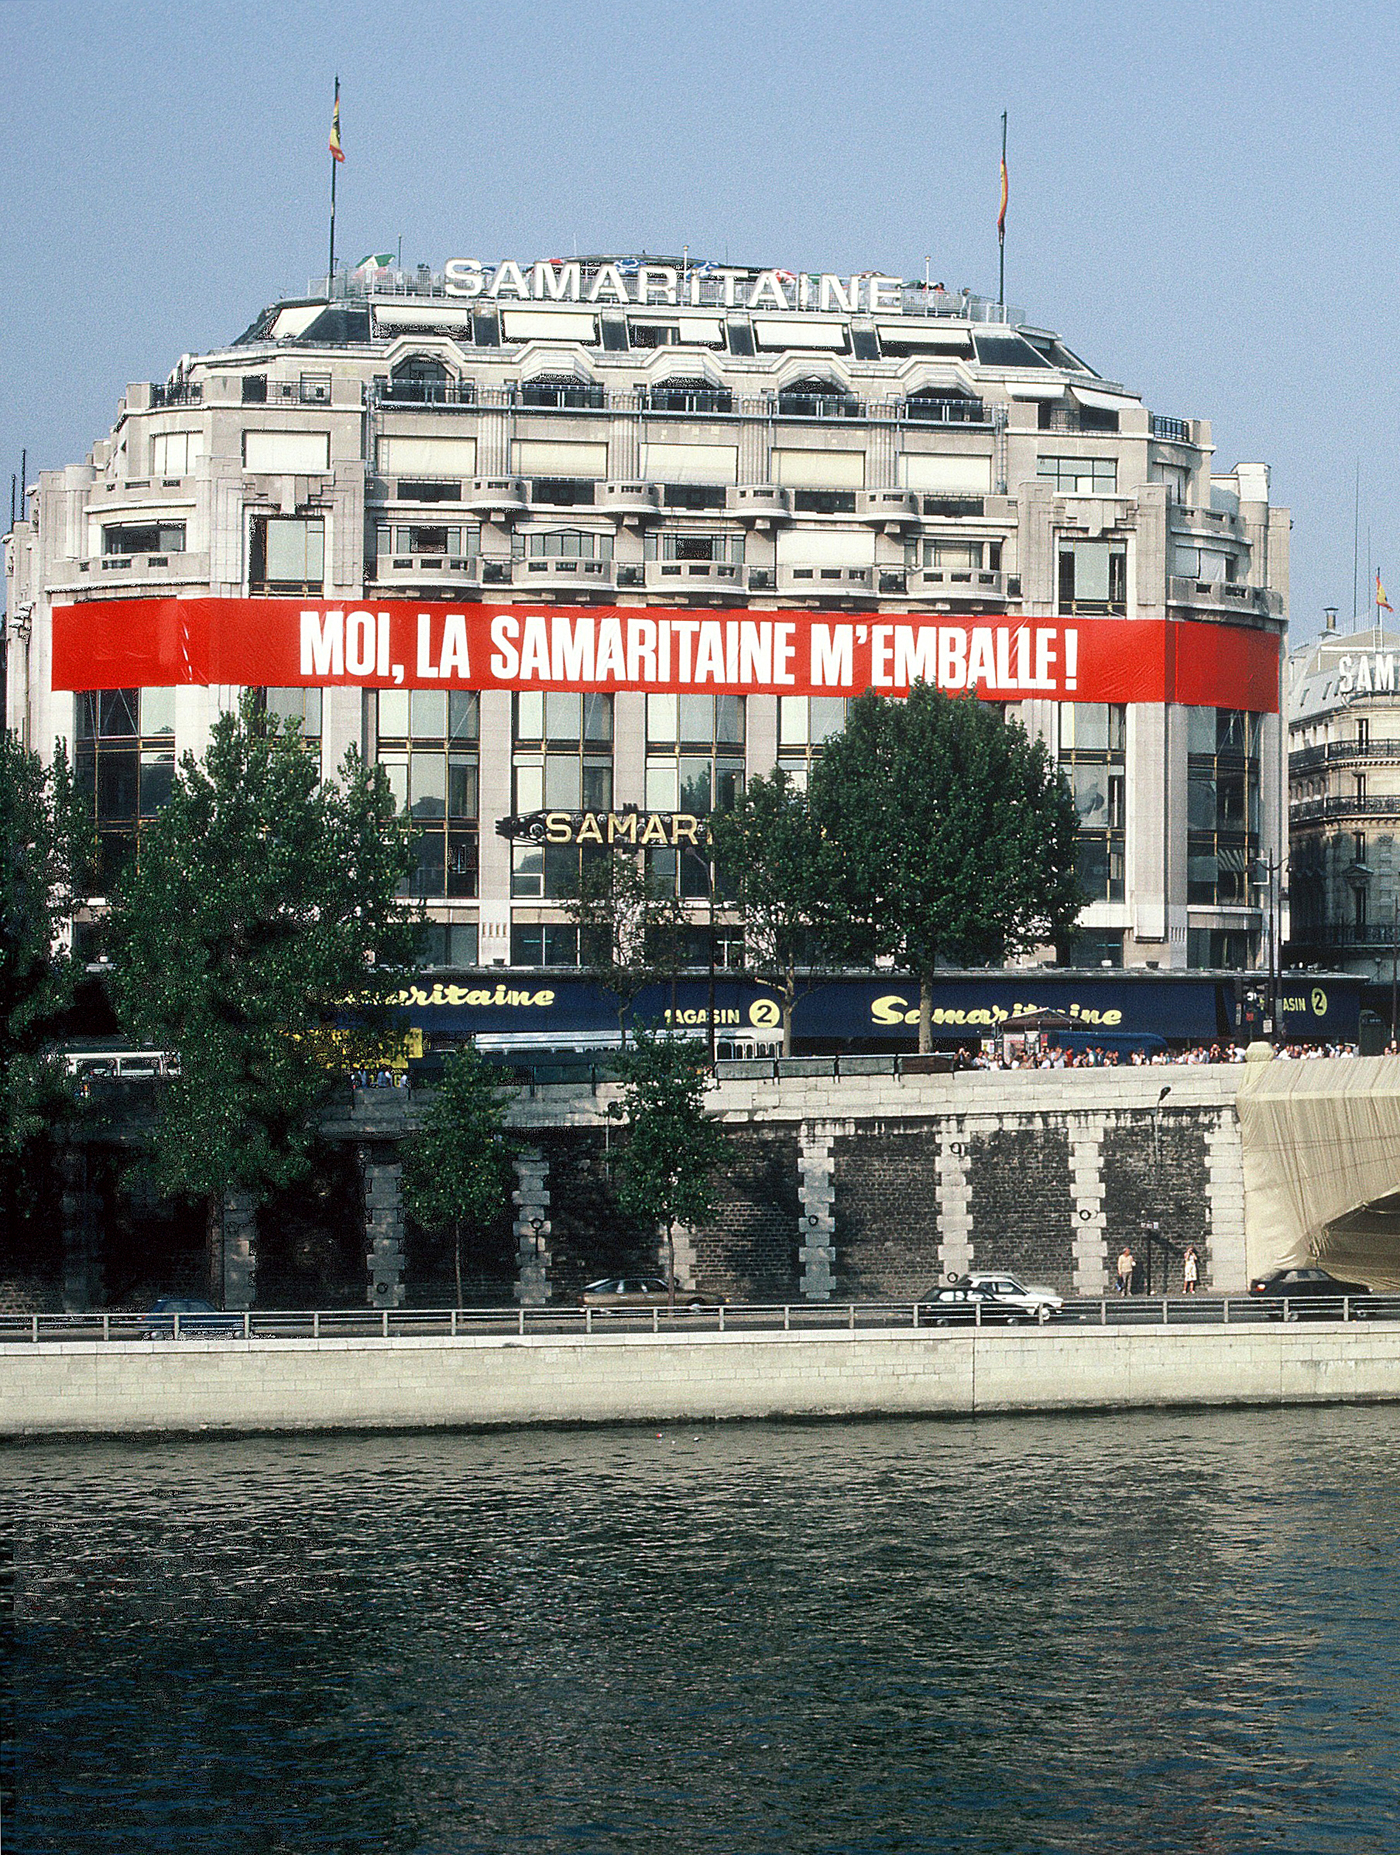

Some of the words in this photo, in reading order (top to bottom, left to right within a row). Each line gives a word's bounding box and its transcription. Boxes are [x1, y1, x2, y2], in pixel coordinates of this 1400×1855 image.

[444, 257, 903, 314] SAMARITAINE
[299, 611, 405, 685] MOI,
[416, 613, 471, 679] LA
[490, 615, 796, 686] SAMARITAINE
[756, 1004, 773, 1023] 2
